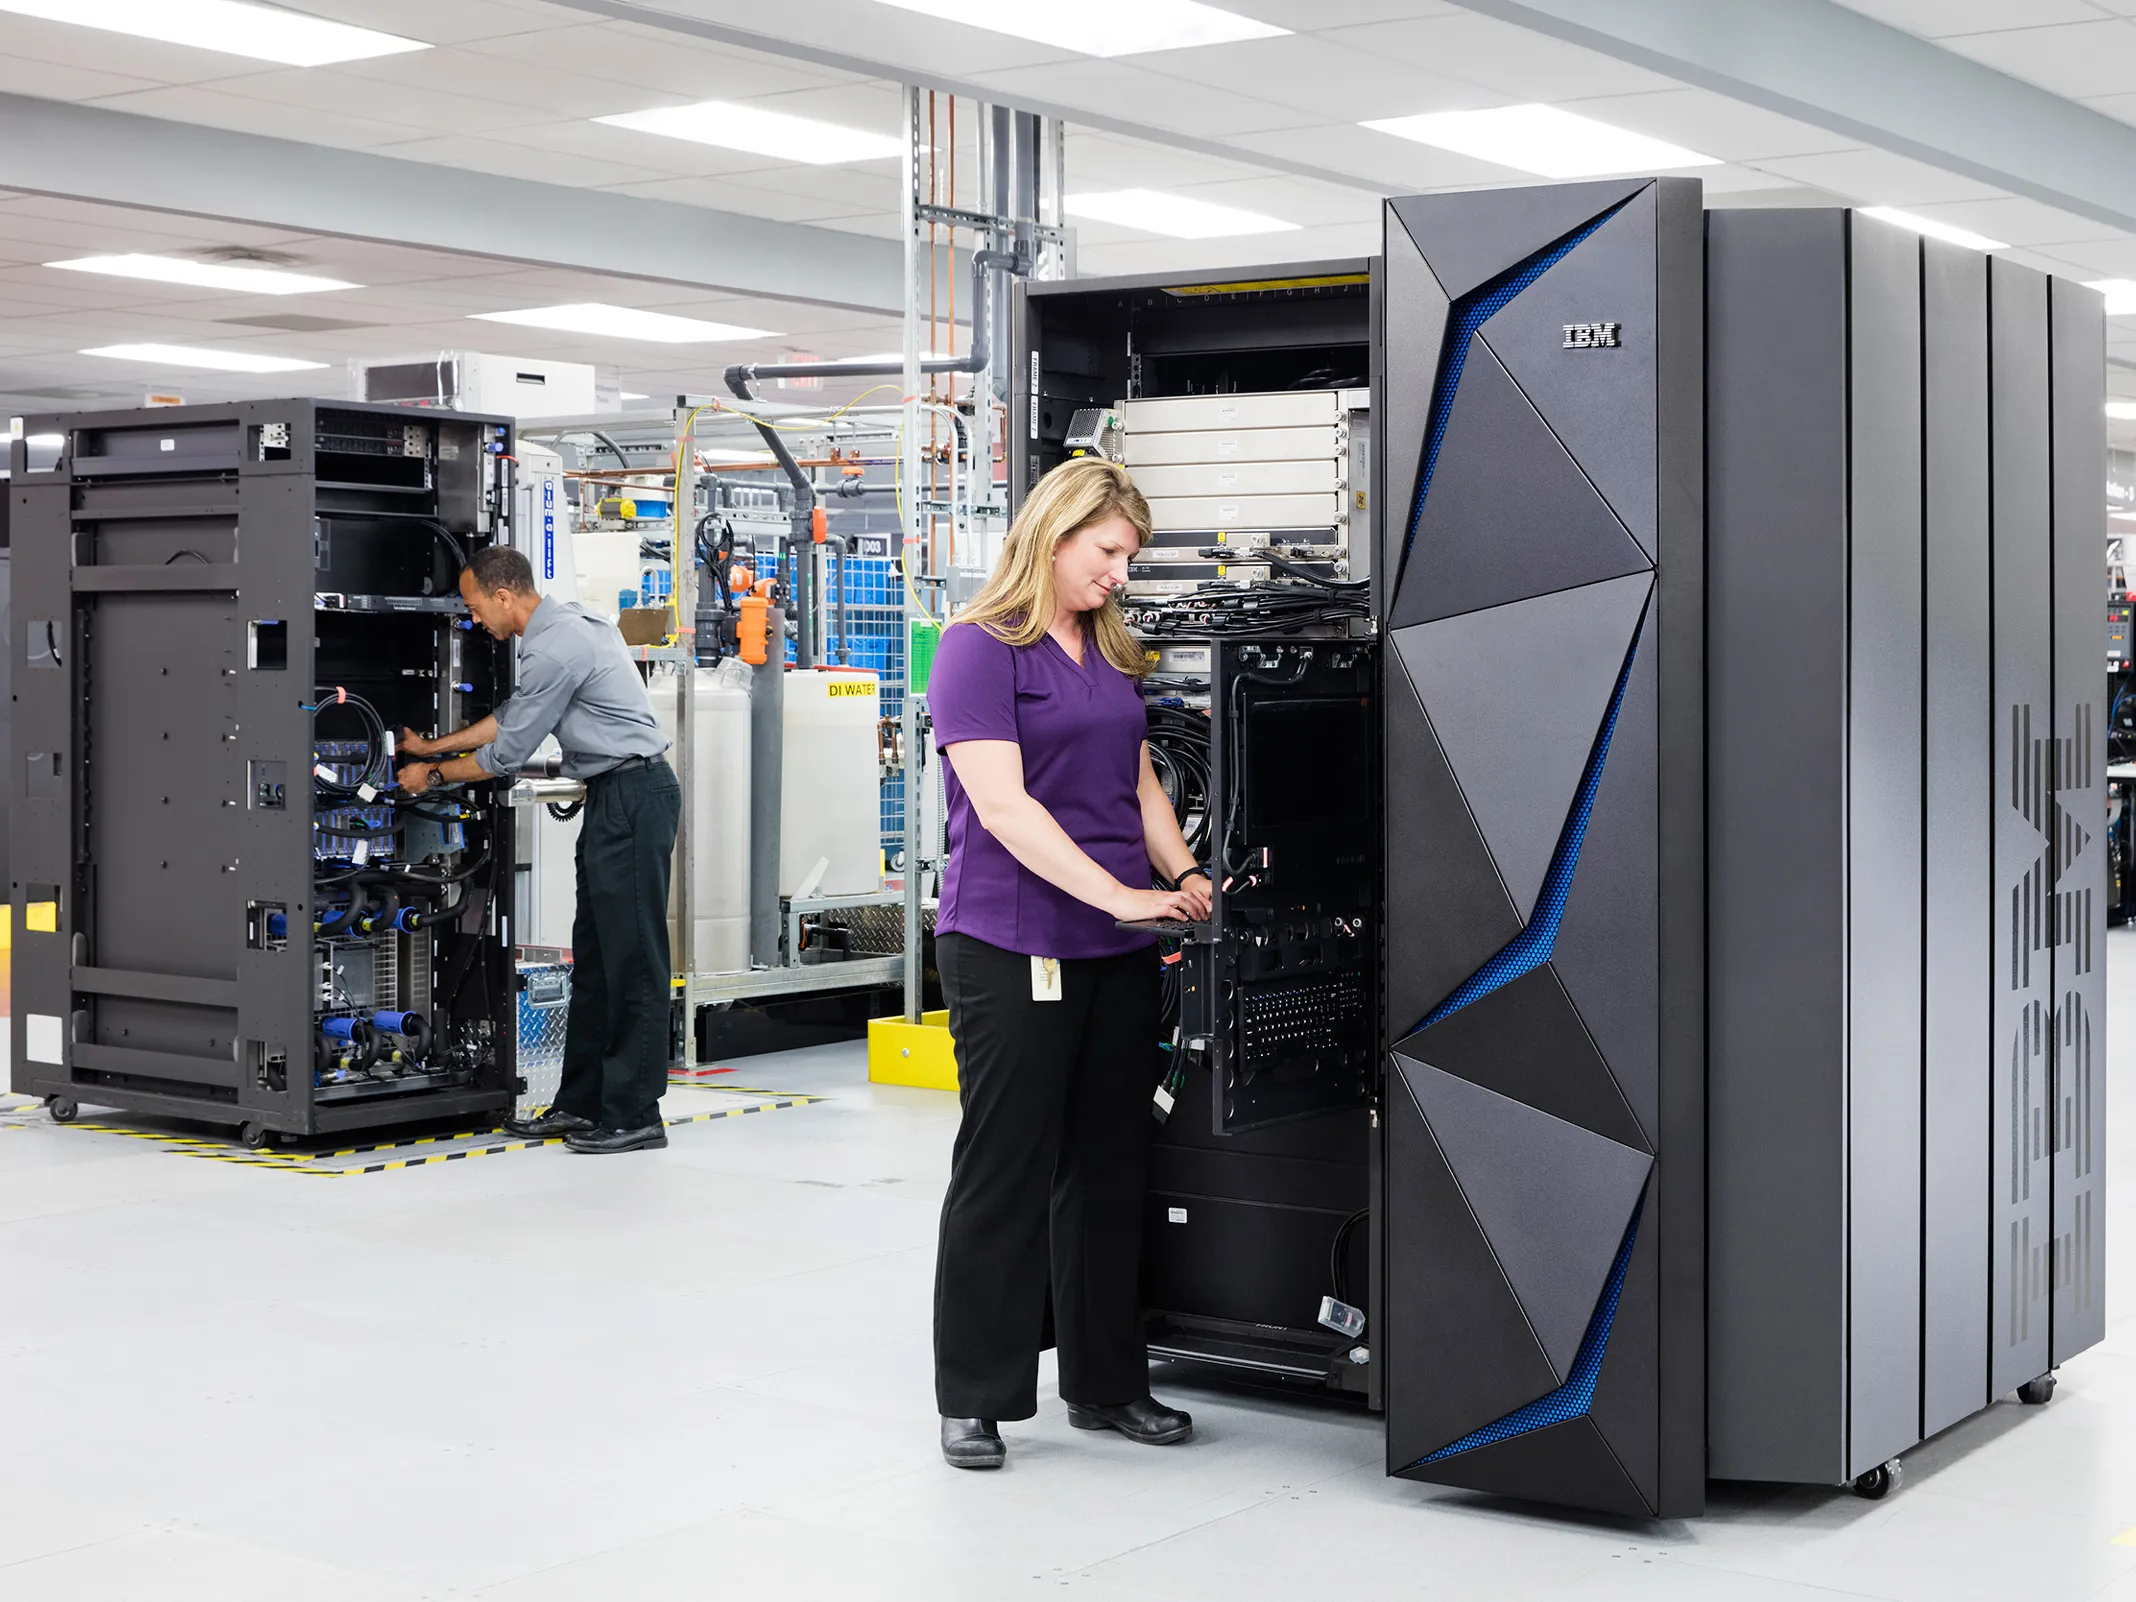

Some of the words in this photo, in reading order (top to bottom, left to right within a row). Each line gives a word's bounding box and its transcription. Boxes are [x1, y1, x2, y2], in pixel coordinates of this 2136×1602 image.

[1563, 322, 1617, 348] IBM
[829, 685, 842, 696] DI
[844, 683, 876, 696] WATER
[2011, 702, 2092, 1349] IBM
